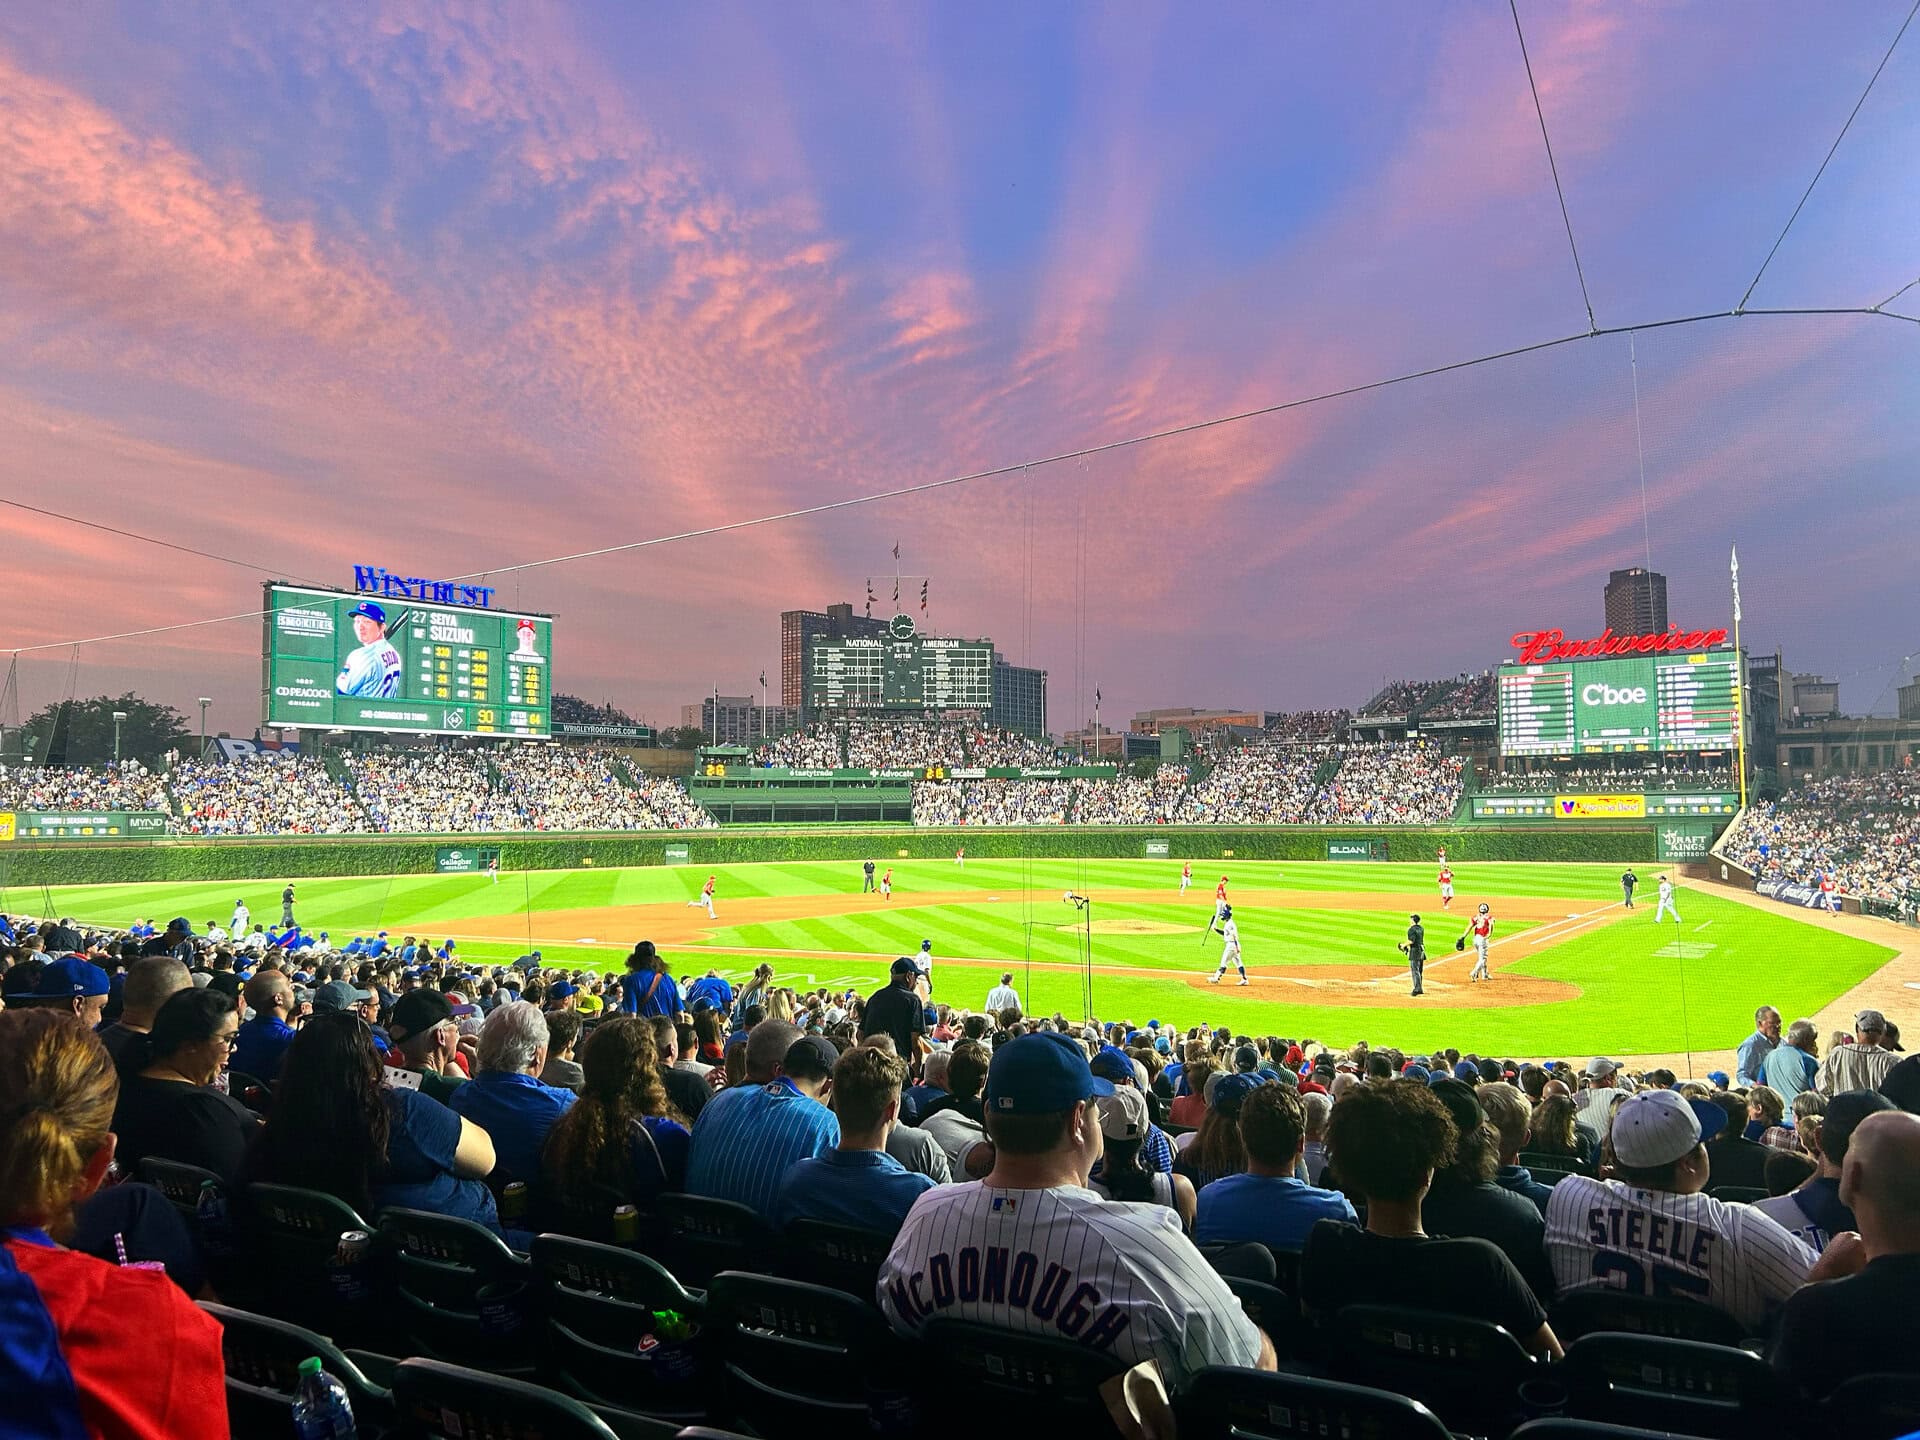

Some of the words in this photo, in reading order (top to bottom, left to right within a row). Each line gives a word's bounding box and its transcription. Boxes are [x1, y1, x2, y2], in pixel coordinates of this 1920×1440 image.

[352, 563, 496, 608] WINTRUST
[411, 610, 427, 623] 27
[430, 612, 457, 626] SEIYA
[430, 625, 473, 644] SUZUKI
[846, 639, 883, 648] NATIONAL
[922, 640, 959, 648] AMERICAN
[1511, 622, 1729, 665] Budweiser
[290, 687, 332, 698] PEACOCK
[1583, 682, 1647, 705] Cboe
[563, 724, 637, 735] WRIGLEYROOFTOPS.COM
[795, 767, 834, 778] tastytrade
[880, 770, 915, 778] Advocate
[1020, 767, 1061, 777] Budweiser
[1329, 846, 1366, 854] SLOAN
[1671, 843, 1706, 851] KINGS
[440, 858, 473, 867] Gallagher
[1588, 1207, 1716, 1271] STEELE
